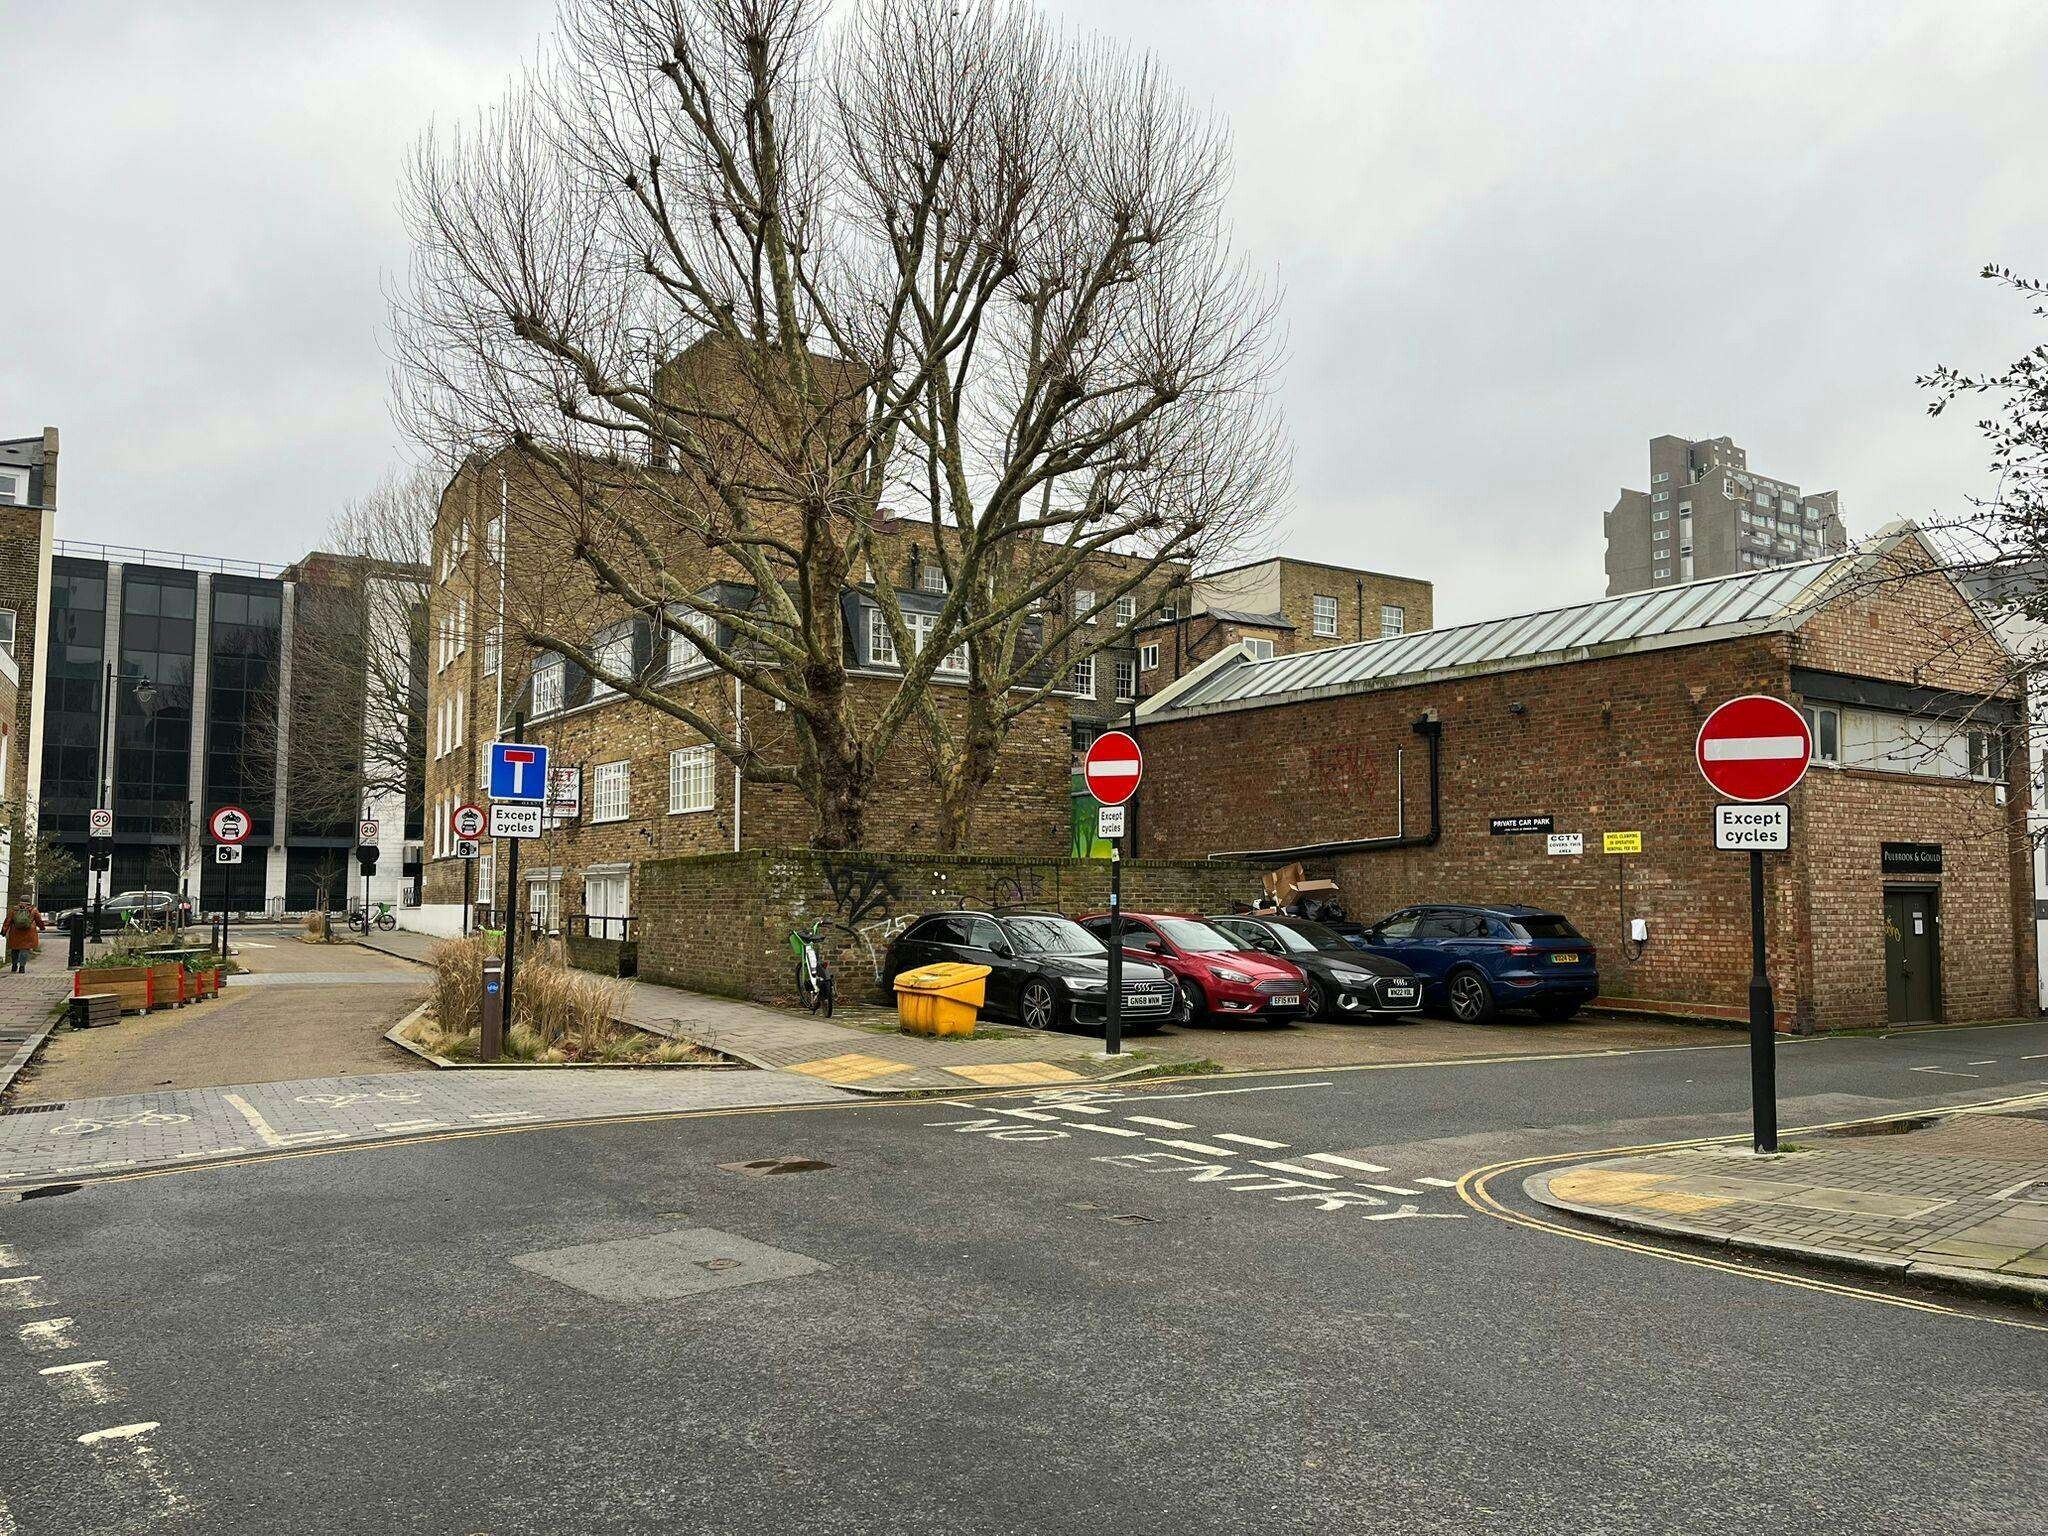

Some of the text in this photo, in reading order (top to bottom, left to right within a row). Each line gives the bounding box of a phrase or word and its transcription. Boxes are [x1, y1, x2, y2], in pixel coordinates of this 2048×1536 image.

[95, 815, 108, 823] 20
[496, 810, 537, 821] Except
[1101, 811, 1122, 821] Except
[1723, 811, 1782, 827] Except
[497, 823, 534, 833] cycles
[1101, 823, 1121, 833] cycles
[1493, 819, 1517, 827] PRIVATE
[1725, 829, 1778, 844] cycles
[1914, 852, 1919, 861] &
[923, 1117, 1070, 1142] NO
[1090, 1152, 1469, 1221] ENTRY
